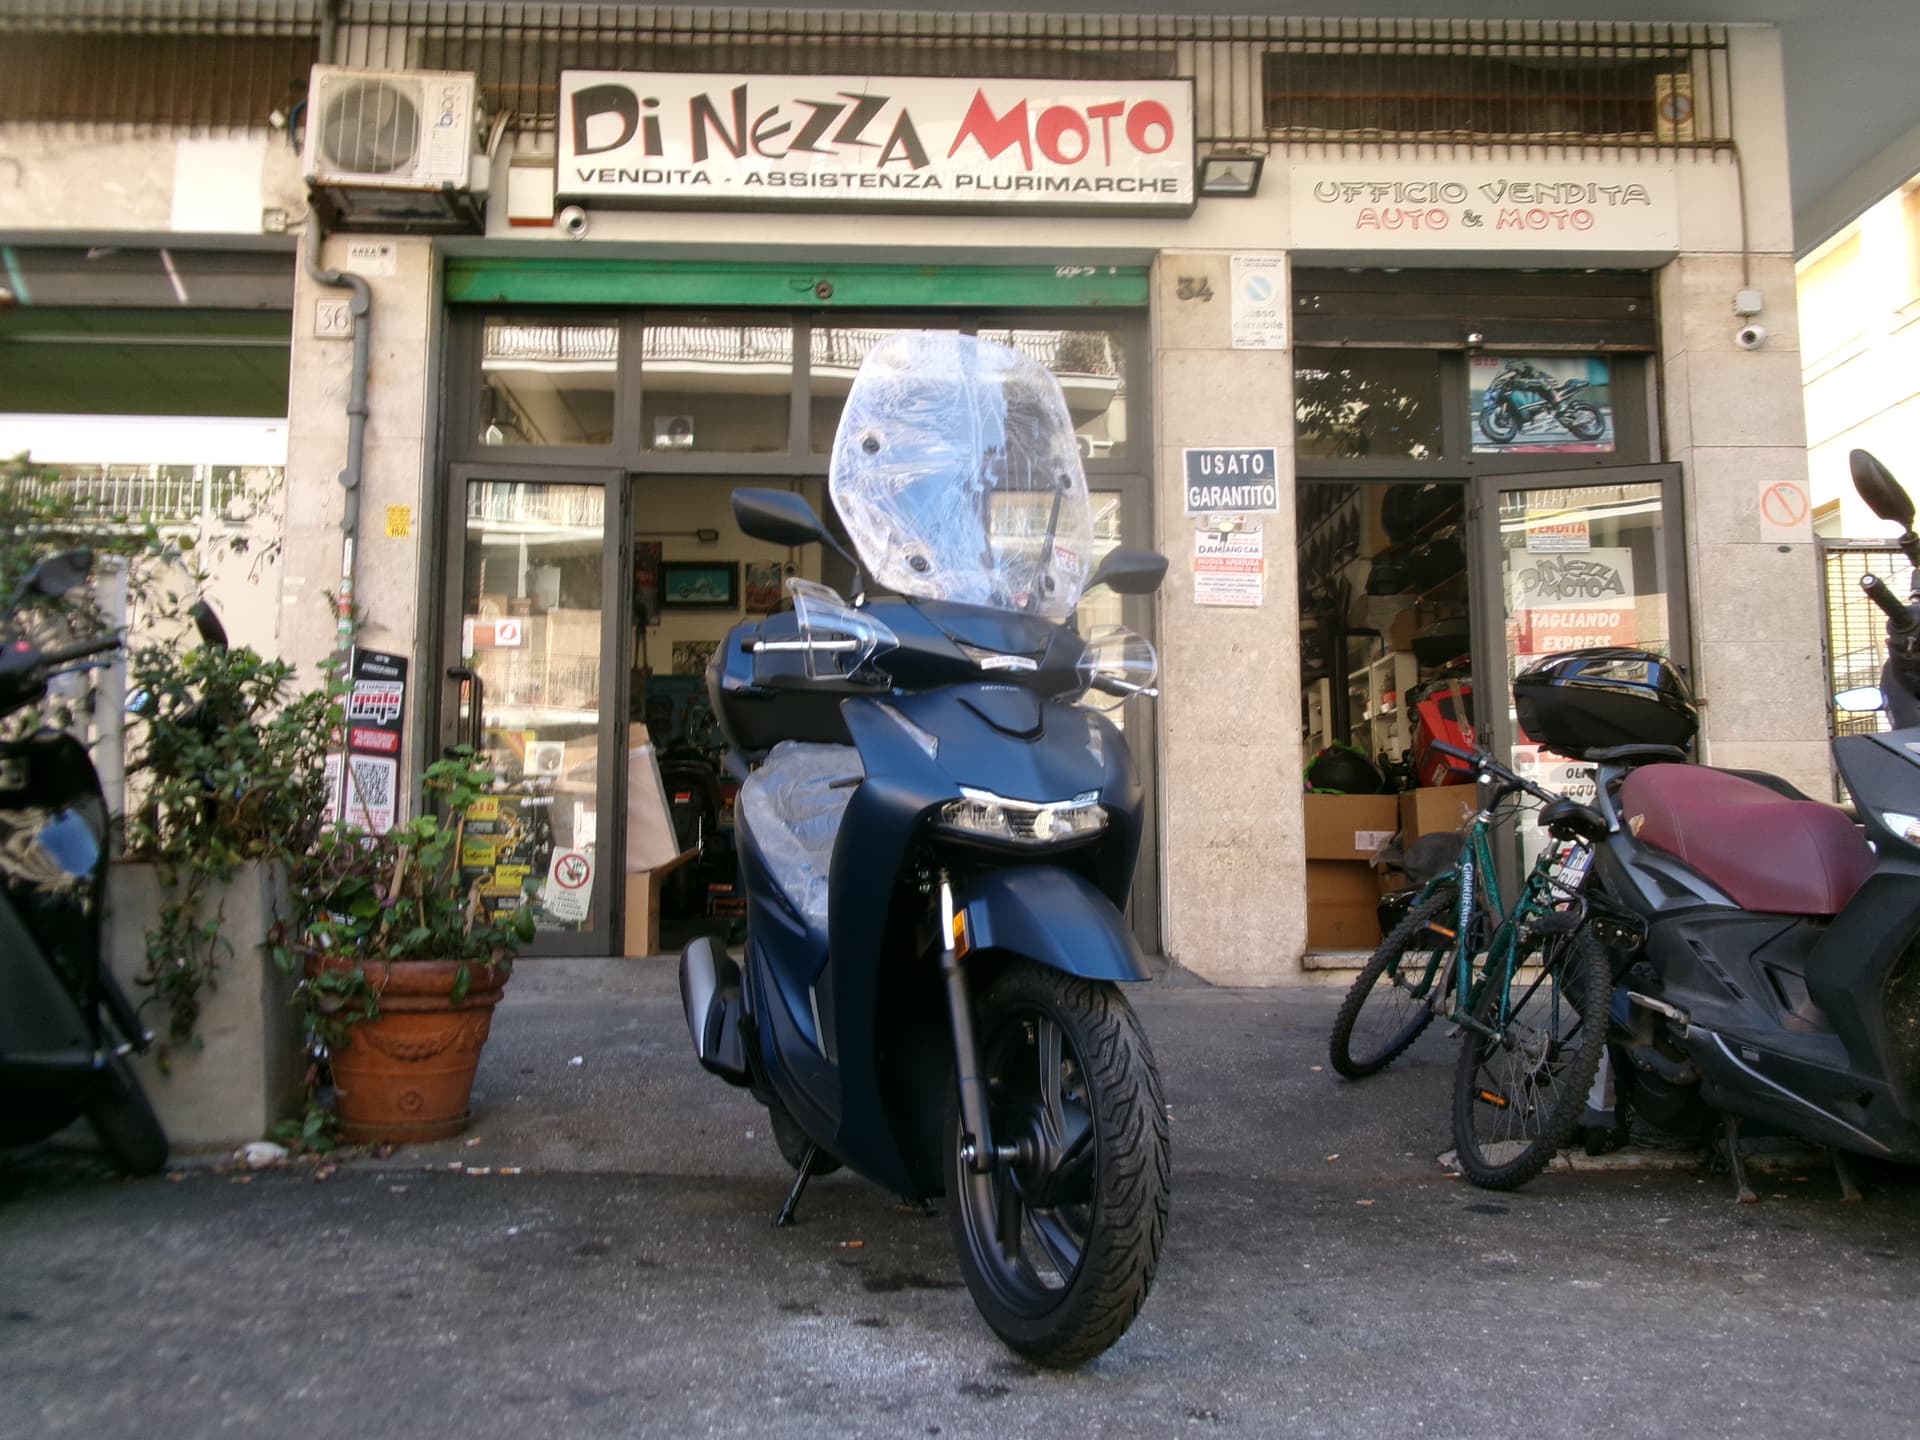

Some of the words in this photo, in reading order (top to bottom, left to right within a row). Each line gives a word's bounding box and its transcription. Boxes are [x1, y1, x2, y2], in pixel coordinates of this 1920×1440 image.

[570, 82, 664, 158] Di
[946, 87, 1174, 171] MOTO
[576, 168, 711, 185] VENDITA
[743, 170, 943, 189] ASSISTENZA
[955, 173, 1179, 193] PLURIMARCHE
[1313, 180, 1468, 204] UFFICIO
[1477, 178, 1652, 206] VENDITA
[1355, 207, 1450, 231] AUTO
[1460, 209, 1485, 228] &
[1495, 208, 1595, 231] MOTO
[1175, 276, 1215, 302] 34
[318, 304, 350, 330] 36
[1200, 453, 1265, 475] USATO
[1189, 485, 1275, 507] GARANTITO
[1198, 545, 1243, 554] DAMIANO
[1530, 612, 1620, 628] TAGLIANDO
[1542, 635, 1612, 651] EXPRESS
[1565, 767, 1586, 779] OLI
[1560, 784, 1597, 797] ACQU
